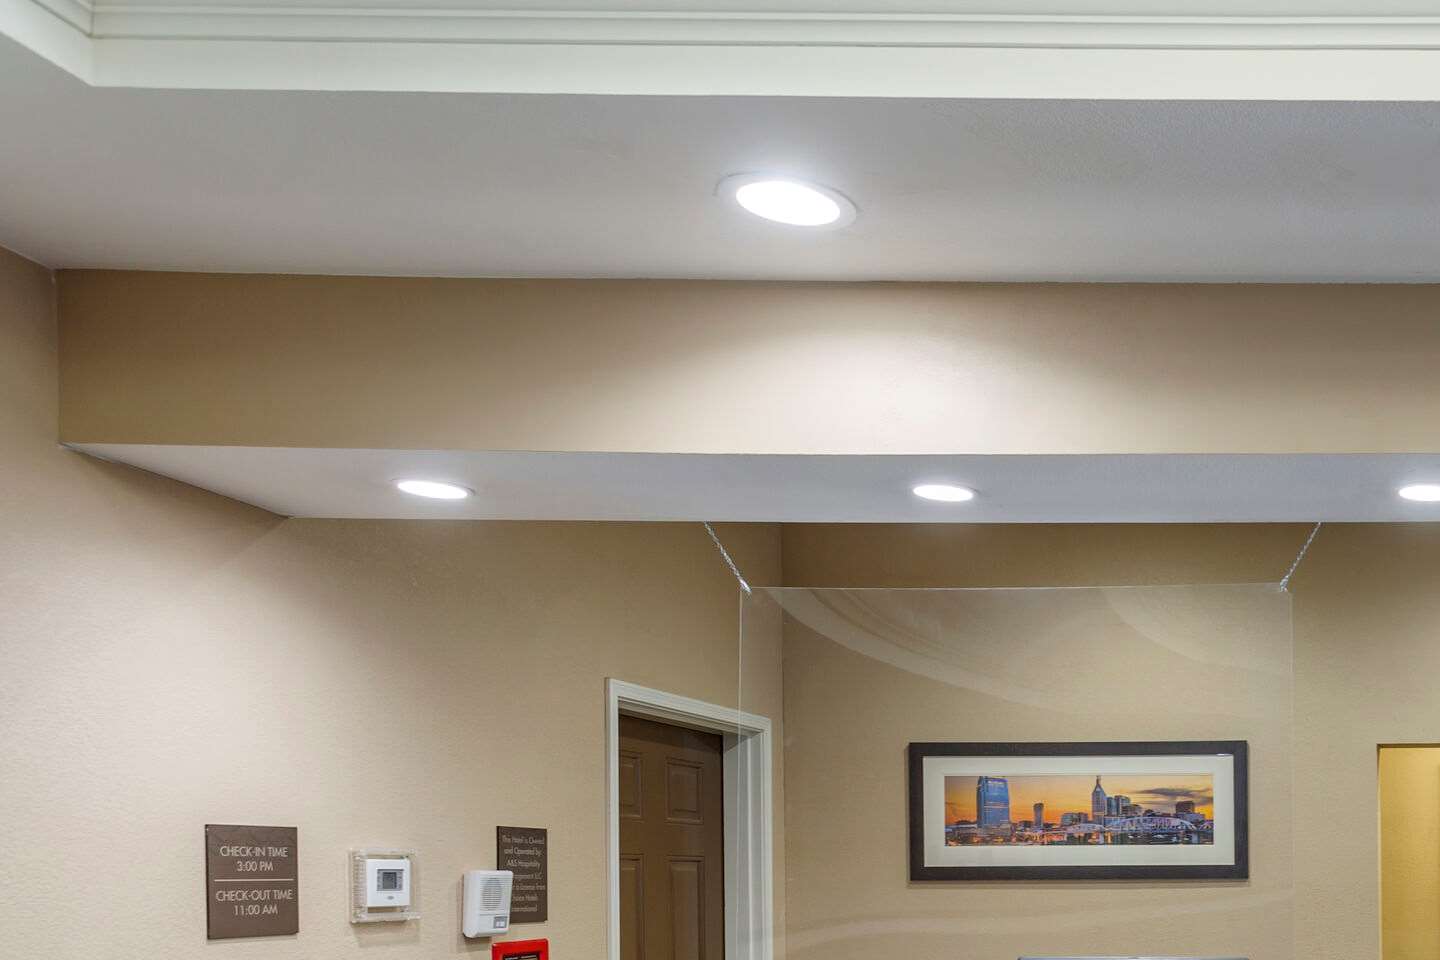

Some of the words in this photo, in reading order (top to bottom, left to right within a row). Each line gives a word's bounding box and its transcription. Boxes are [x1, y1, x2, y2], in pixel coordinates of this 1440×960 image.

[220, 846, 266, 857] CHECK-IN
[268, 846, 289, 857] TIME
[237, 861, 257, 872] 3:00
[260, 861, 274, 871] PM
[215, 890, 271, 902] CHECK-OUT
[272, 889, 294, 900] TIME
[234, 904, 260, 916] 11:00
[262, 904, 279, 915] AM
